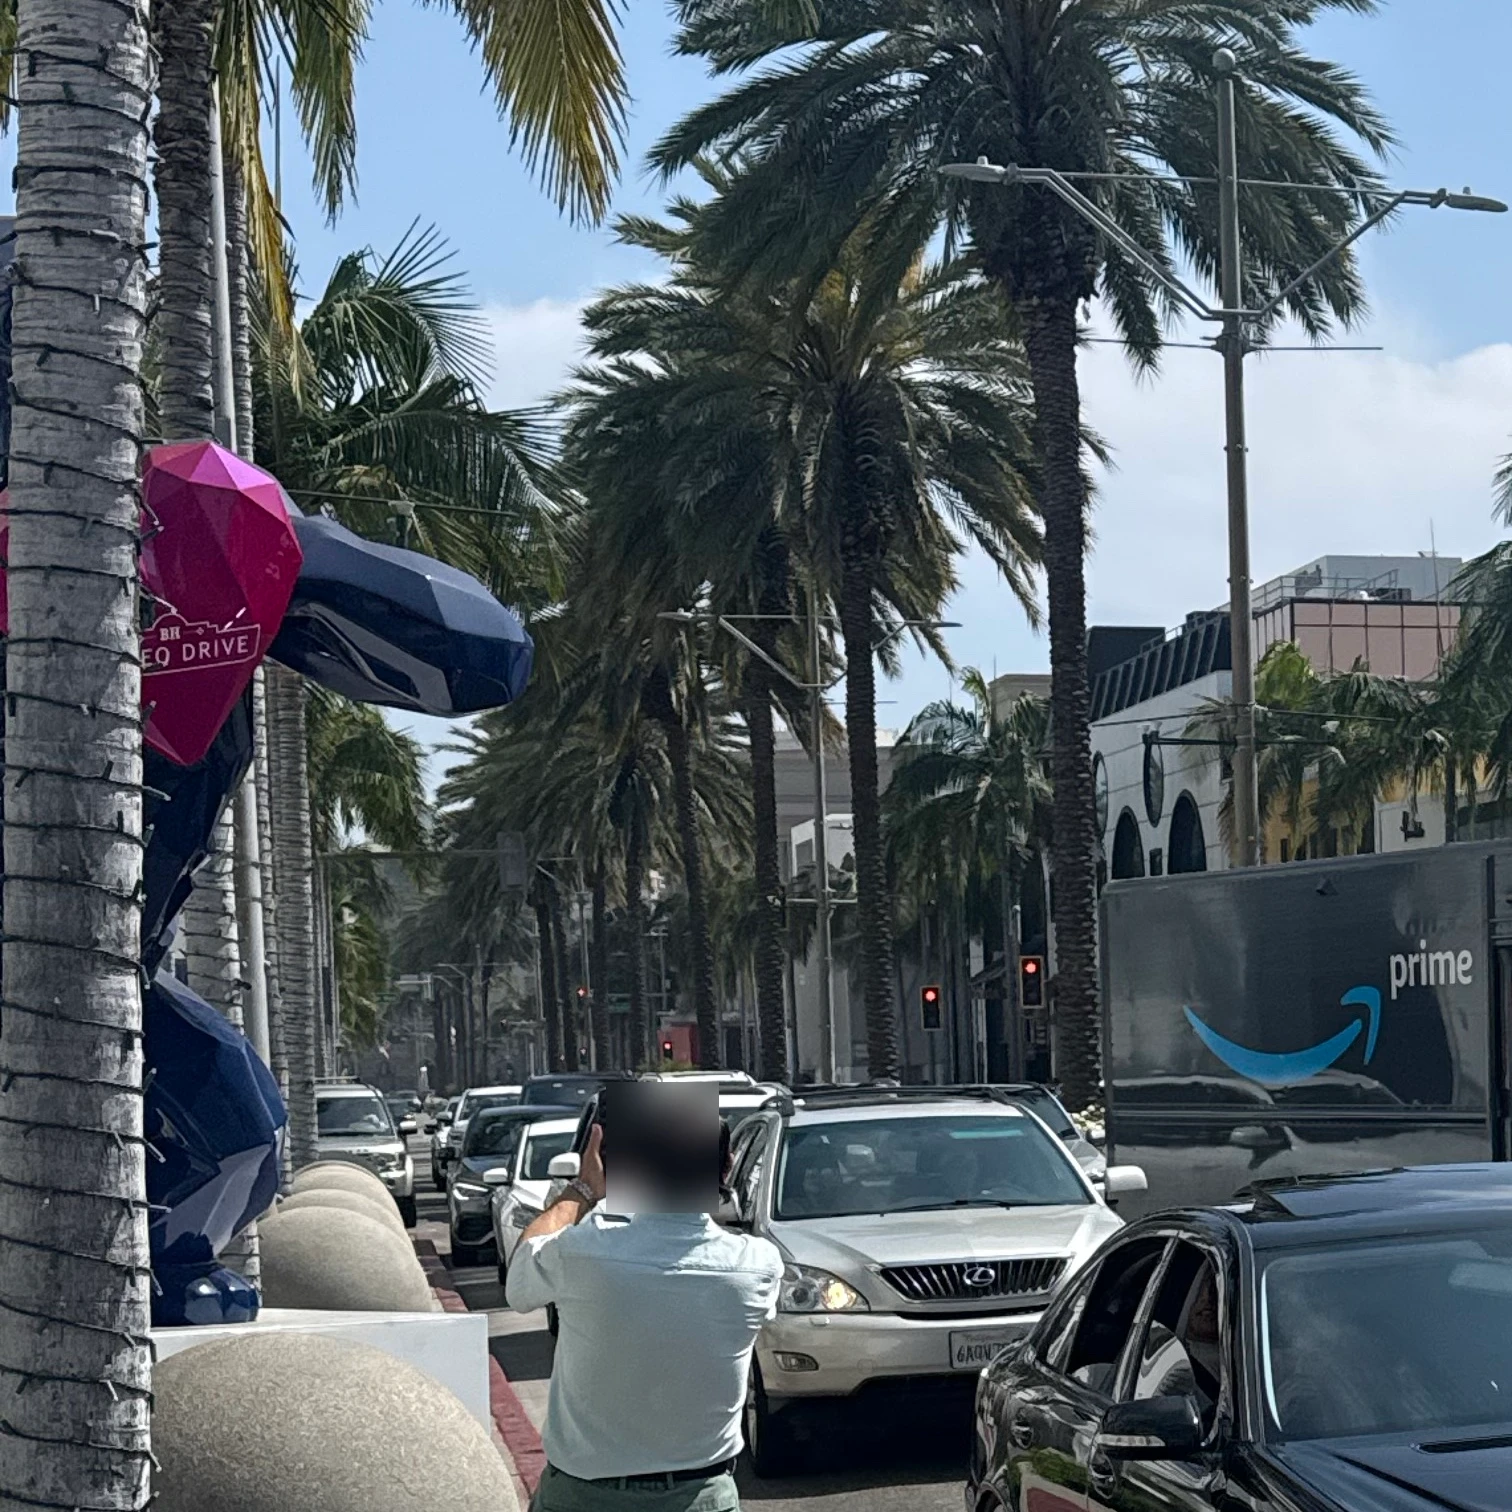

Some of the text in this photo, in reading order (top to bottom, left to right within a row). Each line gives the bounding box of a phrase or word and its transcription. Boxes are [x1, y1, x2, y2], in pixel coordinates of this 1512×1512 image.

[160, 626, 181, 641] BH
[182, 635, 249, 662] DRIVE
[1389, 938, 1473, 1000] prime
